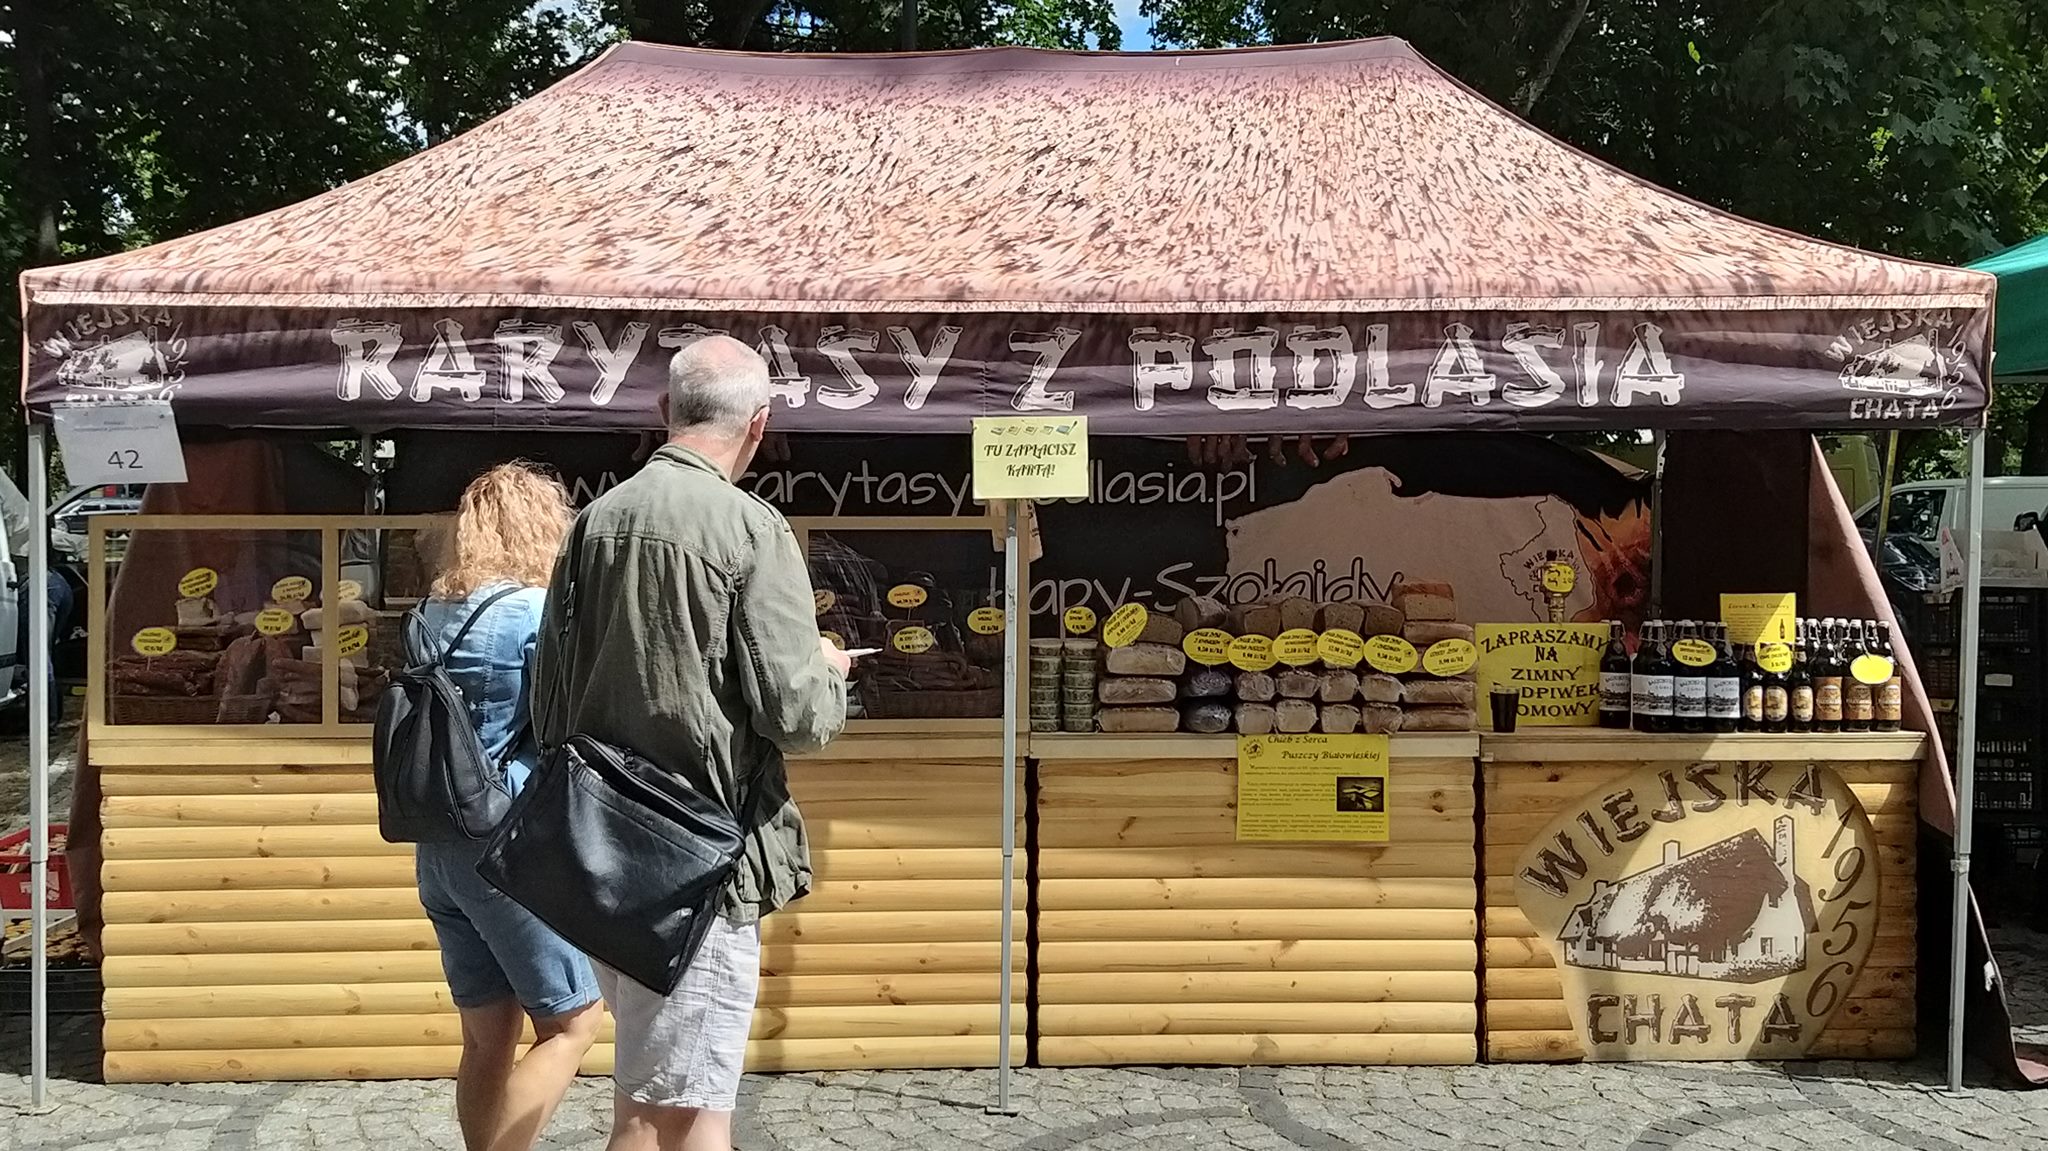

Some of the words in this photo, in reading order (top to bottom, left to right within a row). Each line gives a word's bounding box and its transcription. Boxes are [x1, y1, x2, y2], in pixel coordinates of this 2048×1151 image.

[42, 305, 173, 358] WIEJSKA
[1825, 308, 1954, 362] WIEJSKA
[331, 318, 963, 411] RARYASY
[1009, 326, 1082, 411] Z
[1129, 322, 1686, 411] PODLASIA
[1941, 324, 1968, 409] 1956
[1850, 398, 1940, 420] CHATA
[107, 449, 144, 470] 42
[983, 443, 1003, 457] TU
[1480, 629, 1609, 654] ZAPRASZAMY
[1535, 645, 1559, 663] NA
[1510, 666, 1582, 681] ZIMNY
[1493, 682, 1601, 699] DPIWEK
[1516, 699, 1596, 718] OMOWY
[1519, 760, 1827, 898] WIEJSKA
[1805, 803, 1872, 1018] 1956
[1586, 993, 1802, 1045] CHATA
